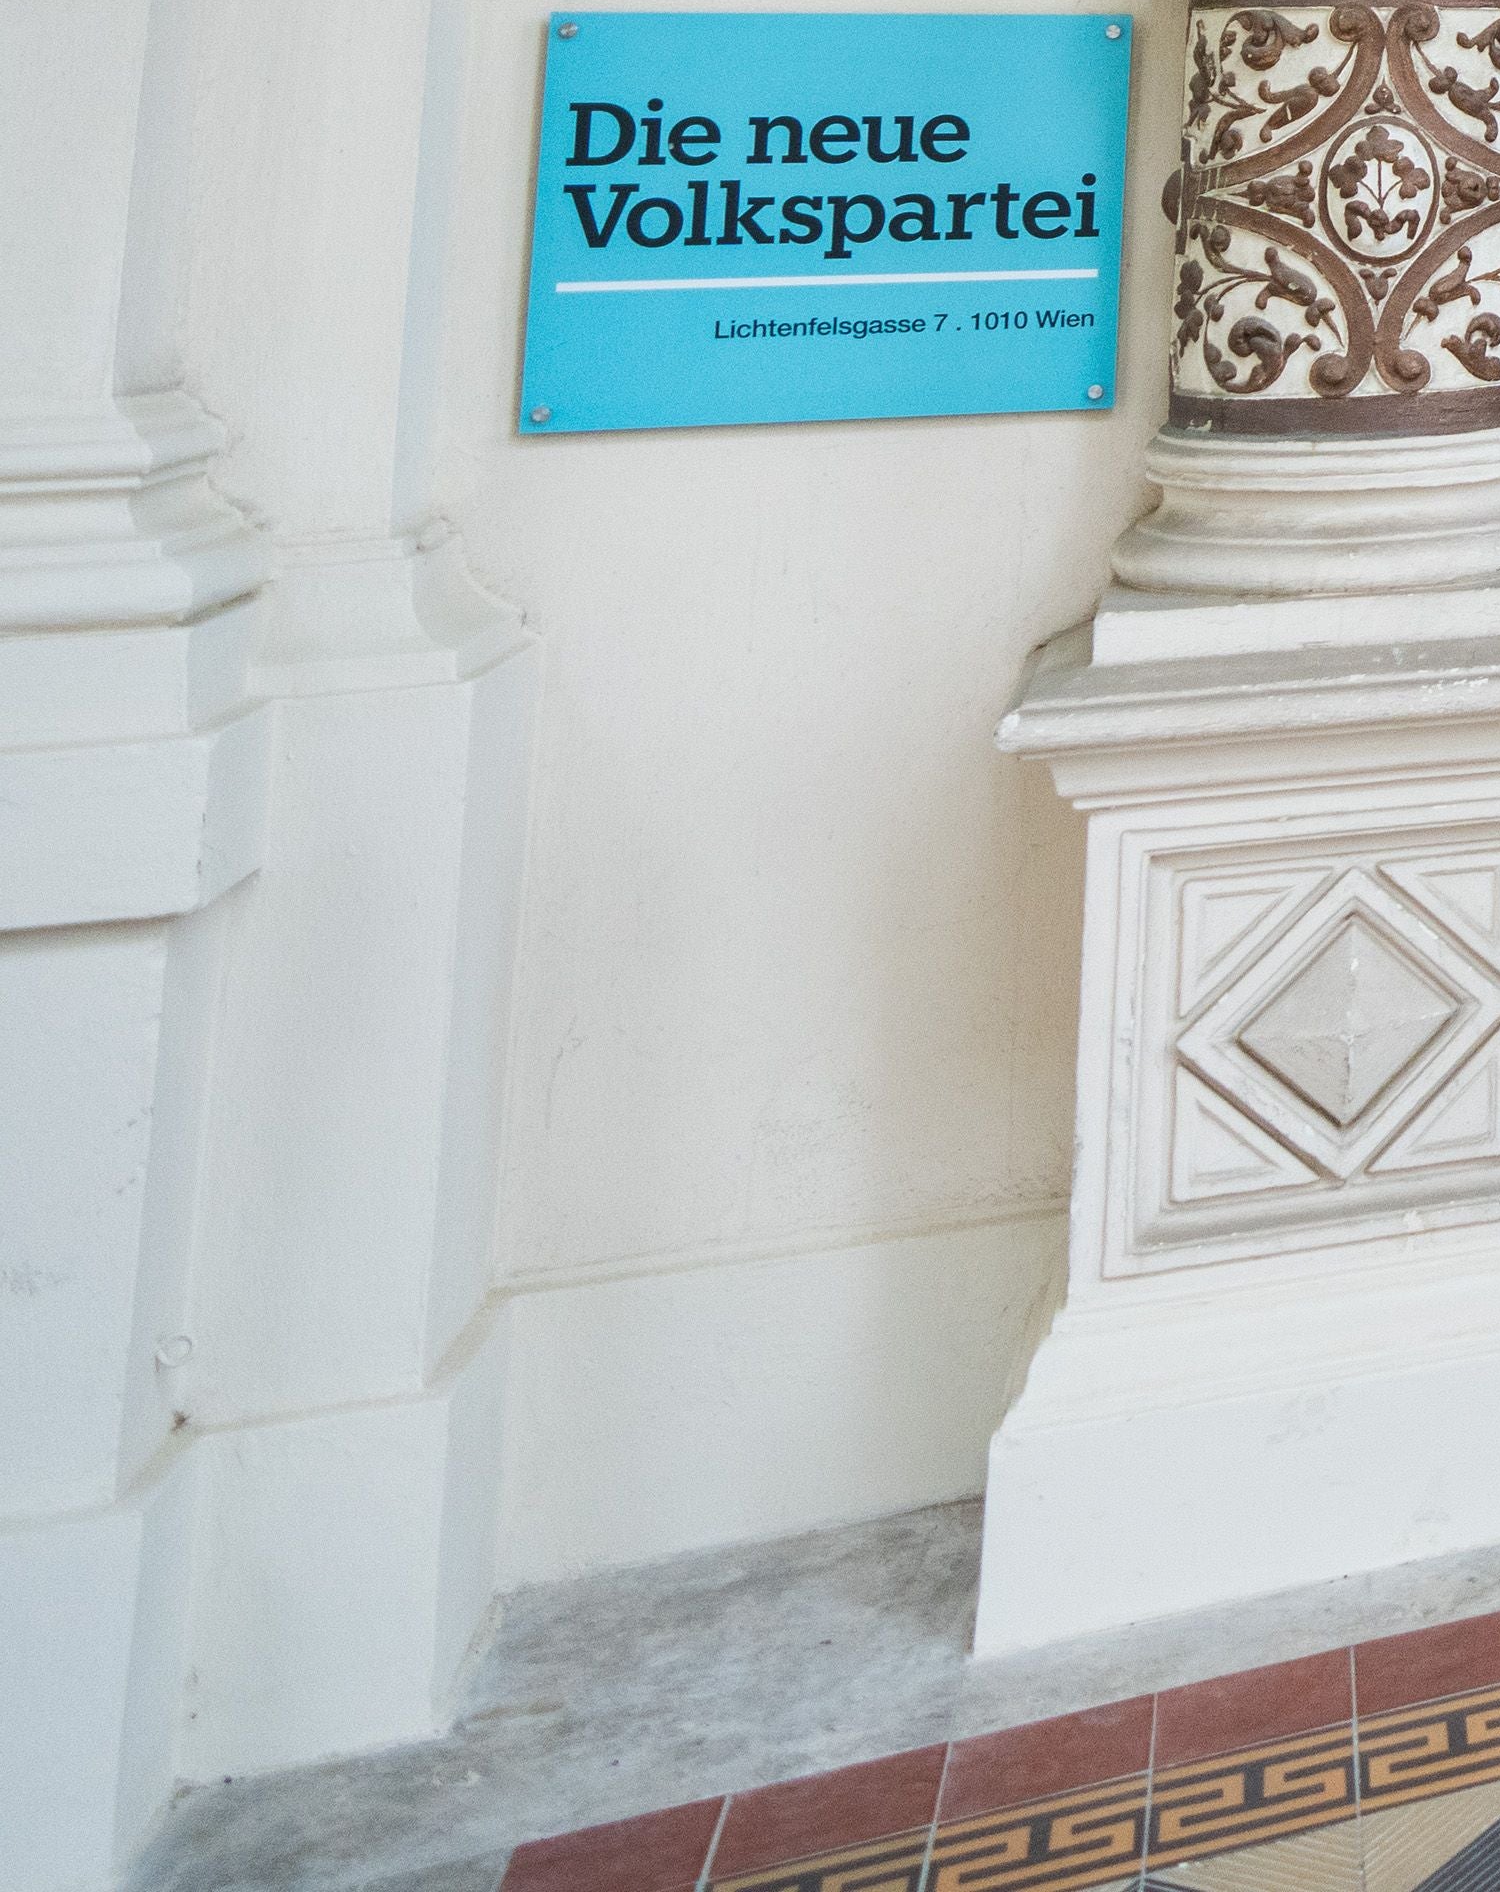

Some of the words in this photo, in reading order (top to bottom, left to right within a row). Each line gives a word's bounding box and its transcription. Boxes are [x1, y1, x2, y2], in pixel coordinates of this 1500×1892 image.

[565, 98, 721, 166] Die
[746, 113, 970, 165] neue
[563, 173, 1100, 259] Volkspartei
[714, 314, 926, 341] Lichtenfelsgasse
[934, 314, 948, 333] 7
[971, 311, 1028, 331] 1010
[1035, 310, 1094, 329] Wien
